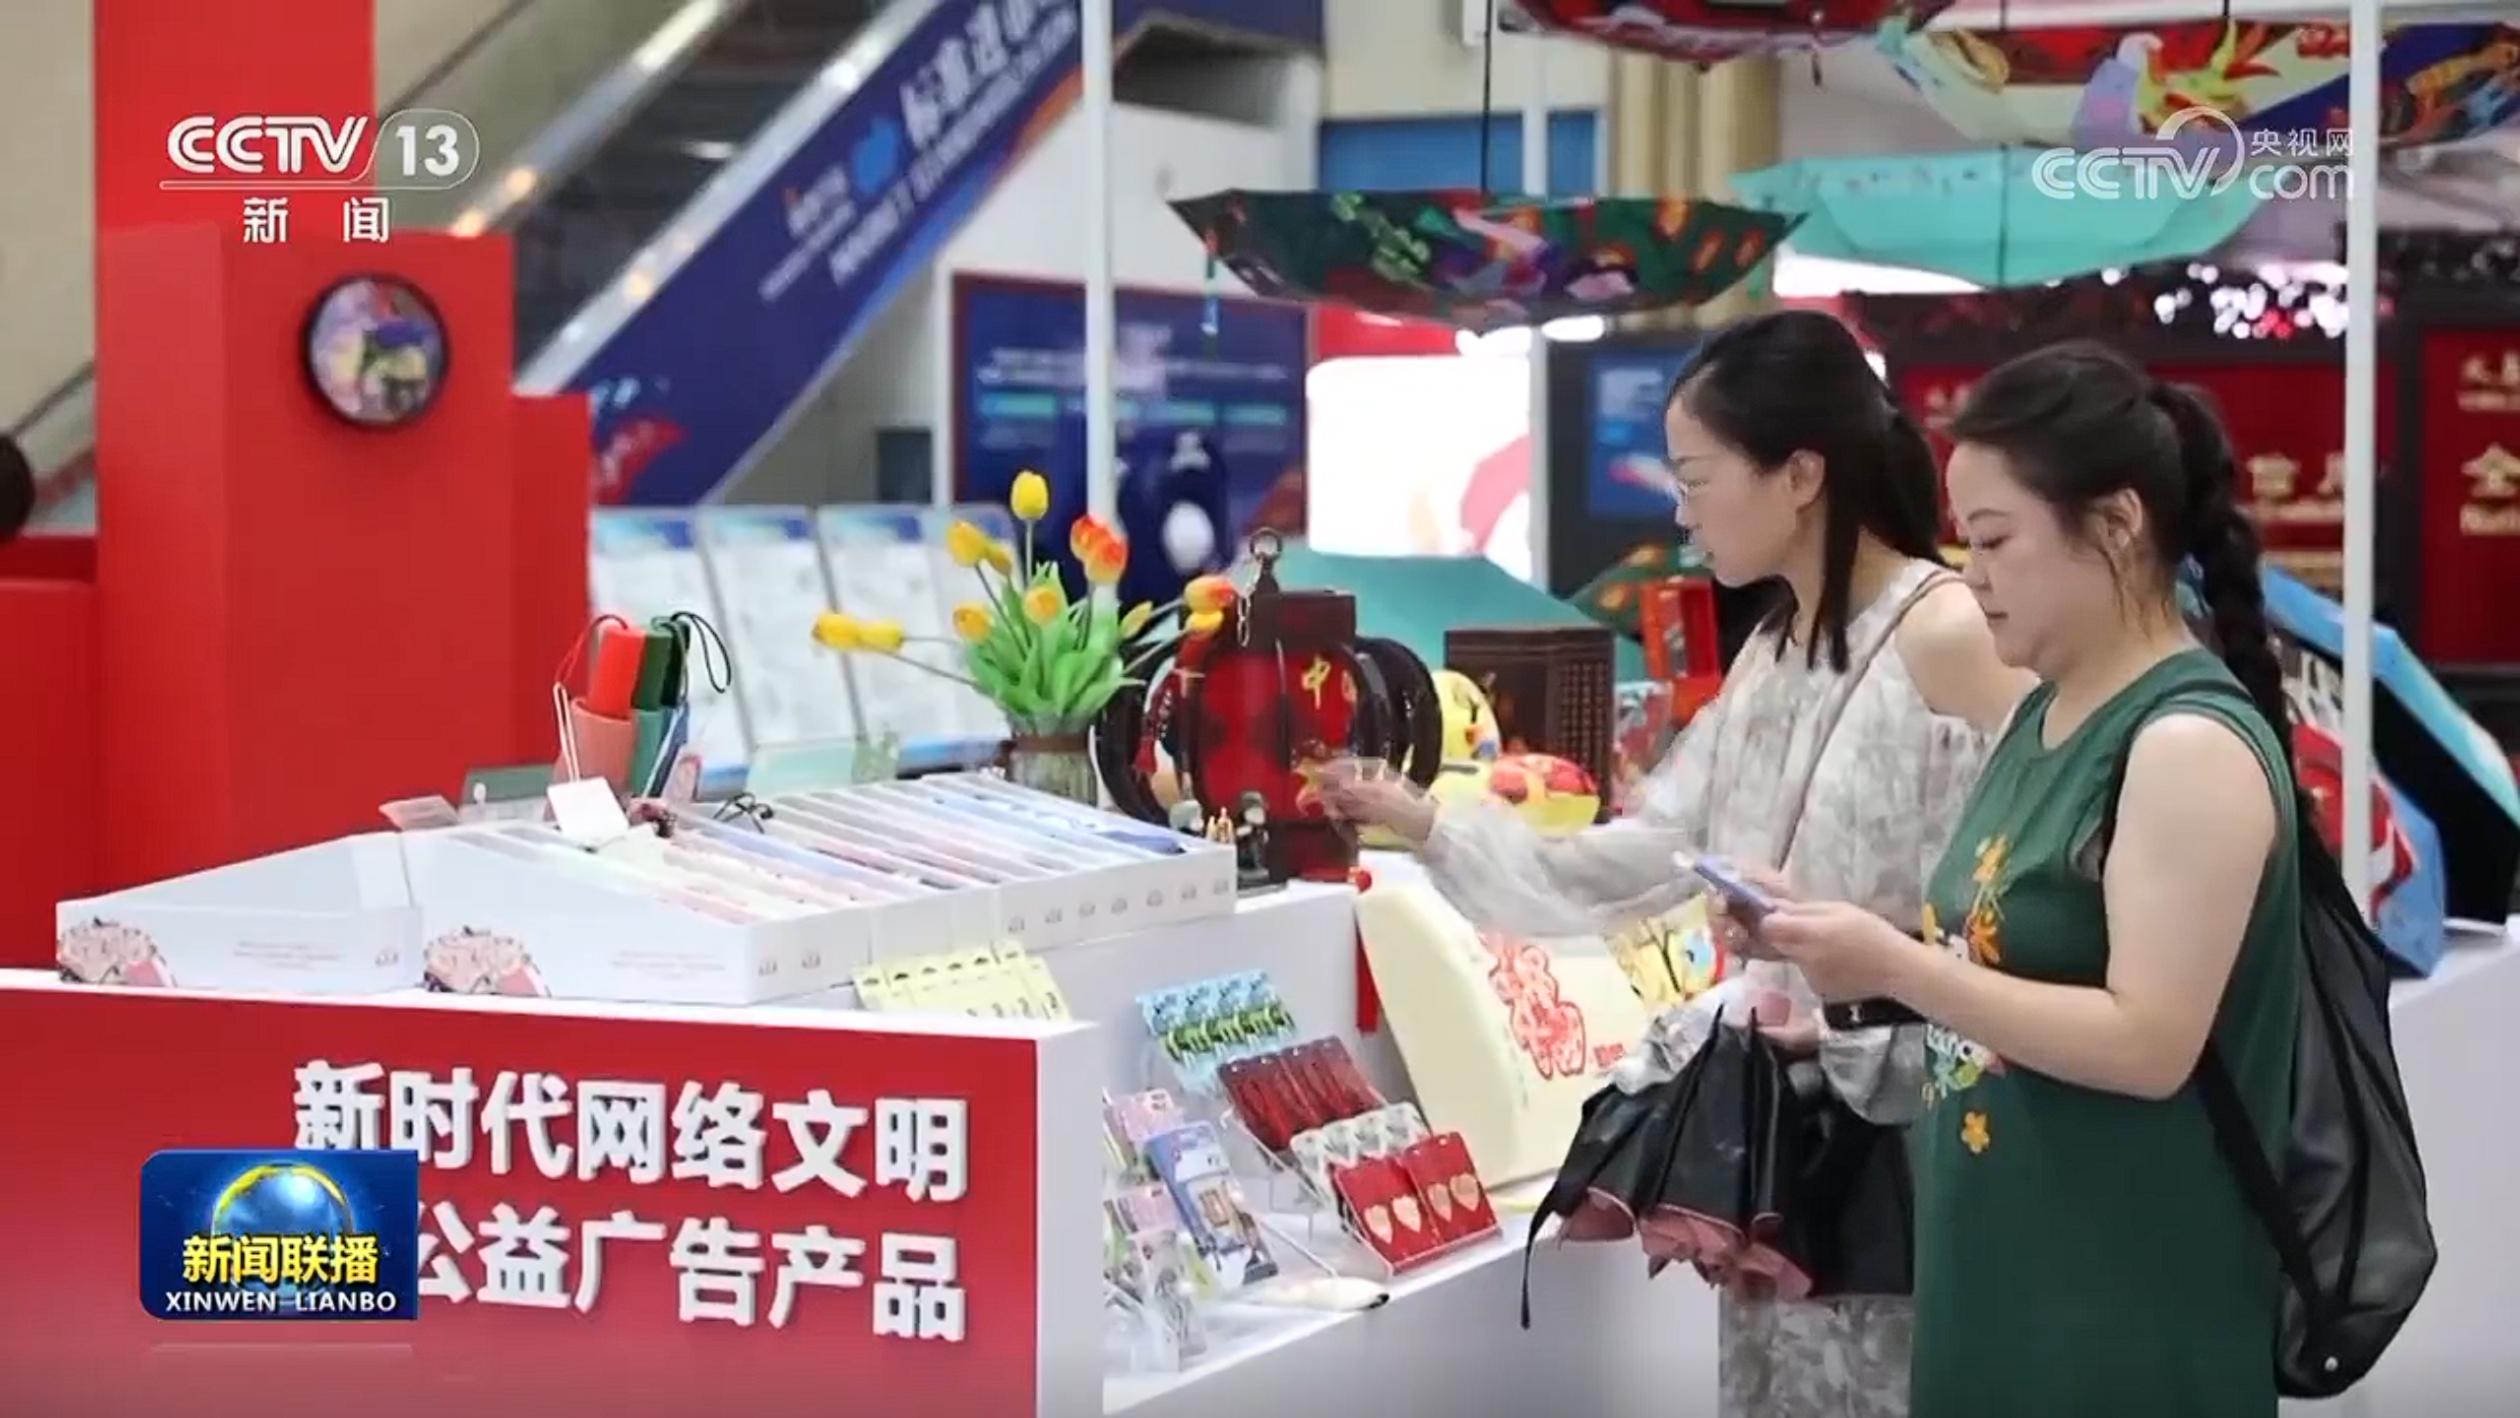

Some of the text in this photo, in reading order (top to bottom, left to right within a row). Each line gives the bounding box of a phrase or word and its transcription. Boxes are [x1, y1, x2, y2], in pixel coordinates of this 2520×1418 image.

[294, 1060, 968, 1202] 新时代网络文明
